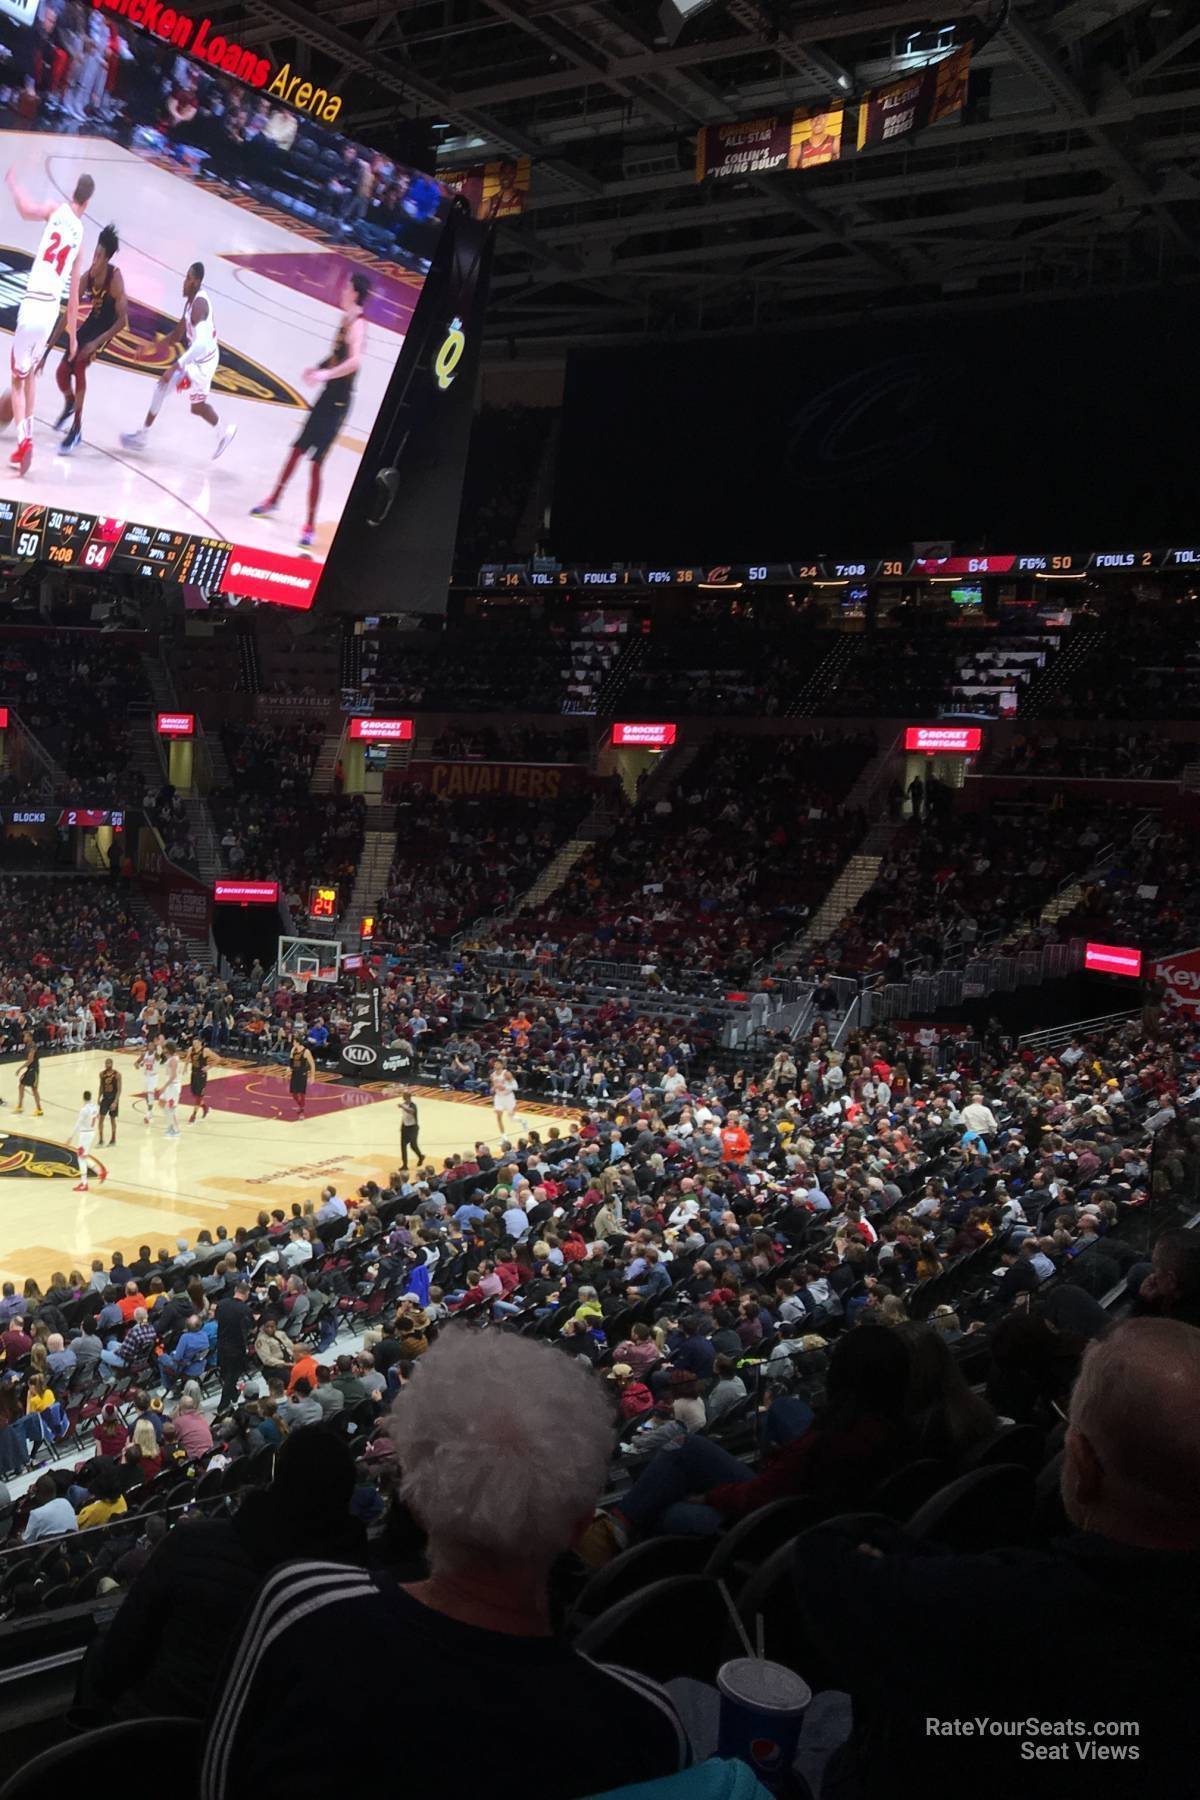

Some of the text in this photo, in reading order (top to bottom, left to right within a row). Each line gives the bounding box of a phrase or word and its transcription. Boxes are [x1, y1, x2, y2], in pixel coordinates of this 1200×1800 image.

[190, 18, 343, 122] Loans Arena
[724, 147, 770, 165] COLLIN'S
[43, 232, 72, 276] 24
[435, 328, 465, 389] Q
[78, 520, 91, 532] 24
[16, 533, 39, 556] 50
[129, 544, 138, 555] 2
[47, 545, 74, 563] 7:08
[84, 544, 107, 567] 64
[1096, 553, 1153, 567] FOULS 2
[1174, 550, 1200, 564] TOL:
[967, 559, 988, 573] 64
[1019, 556, 1072, 570] FG% 50
[748, 567, 767, 581] 50
[800, 565, 817, 577] 24
[835, 564, 866, 577] 7:08
[500, 574, 519, 586] -14
[531, 573, 568, 585] TOL: 5
[583, 573, 629, 584] FOULS 1
[648, 571, 671, 584] FG%
[269, 696, 331, 706] WESTFIELD
[631, 726, 666, 734] ROCKET
[928, 730, 969, 739] ROCKET
[918, 739, 968, 748] MORTGAGE
[13, 812, 45, 822] BLOCKS
[68, 812, 76, 824] 2
[314, 899, 333, 914] 24
[347, 1047, 371, 1061] KIA
